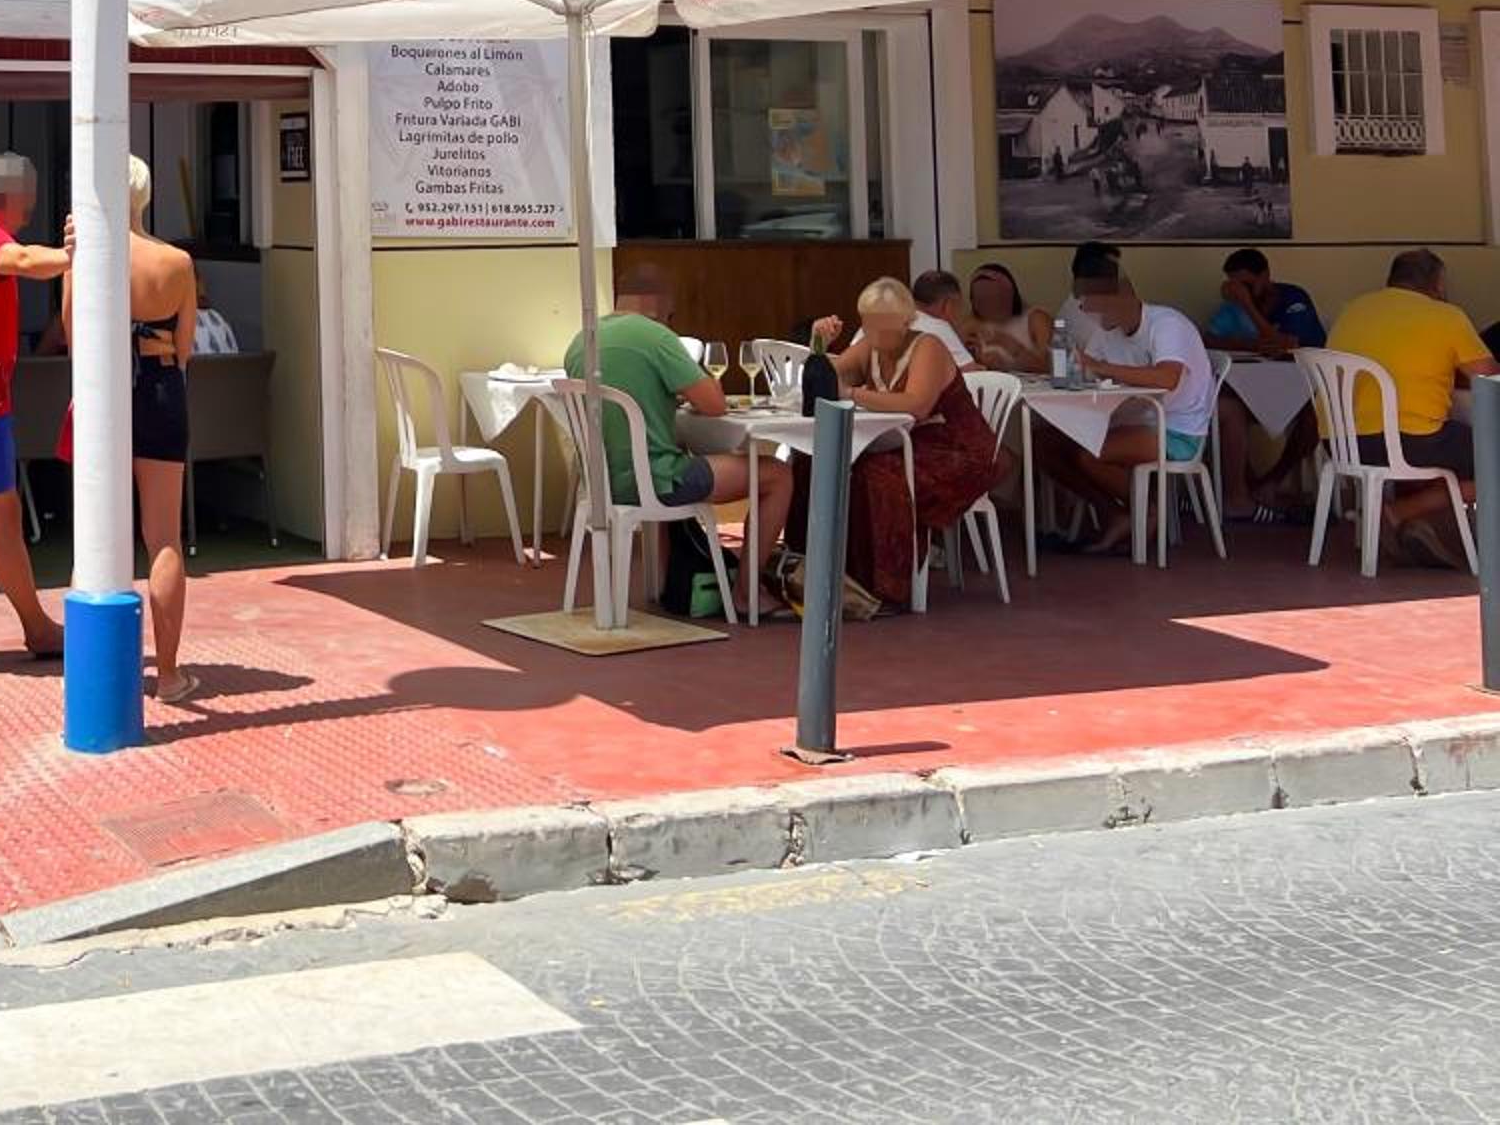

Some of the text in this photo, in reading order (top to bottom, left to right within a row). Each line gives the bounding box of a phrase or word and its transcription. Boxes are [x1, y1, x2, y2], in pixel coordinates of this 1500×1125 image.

[391, 44, 467, 62] Boquerones
[469, 46, 481, 60] al
[425, 62, 491, 77] Calamares
[437, 80, 480, 93] Adobo
[424, 97, 493, 111] Pulpo Frito
[395, 112, 521, 128] Fritura Variada GABI
[399, 129, 519, 147] Lagrimitas de pollo
[432, 148, 486, 161] Jurelitos
[427, 164, 492, 178] Vitorianos
[415, 181, 504, 195] Gambas Fritas
[405, 217, 556, 230] www.gabirestaurante.com
